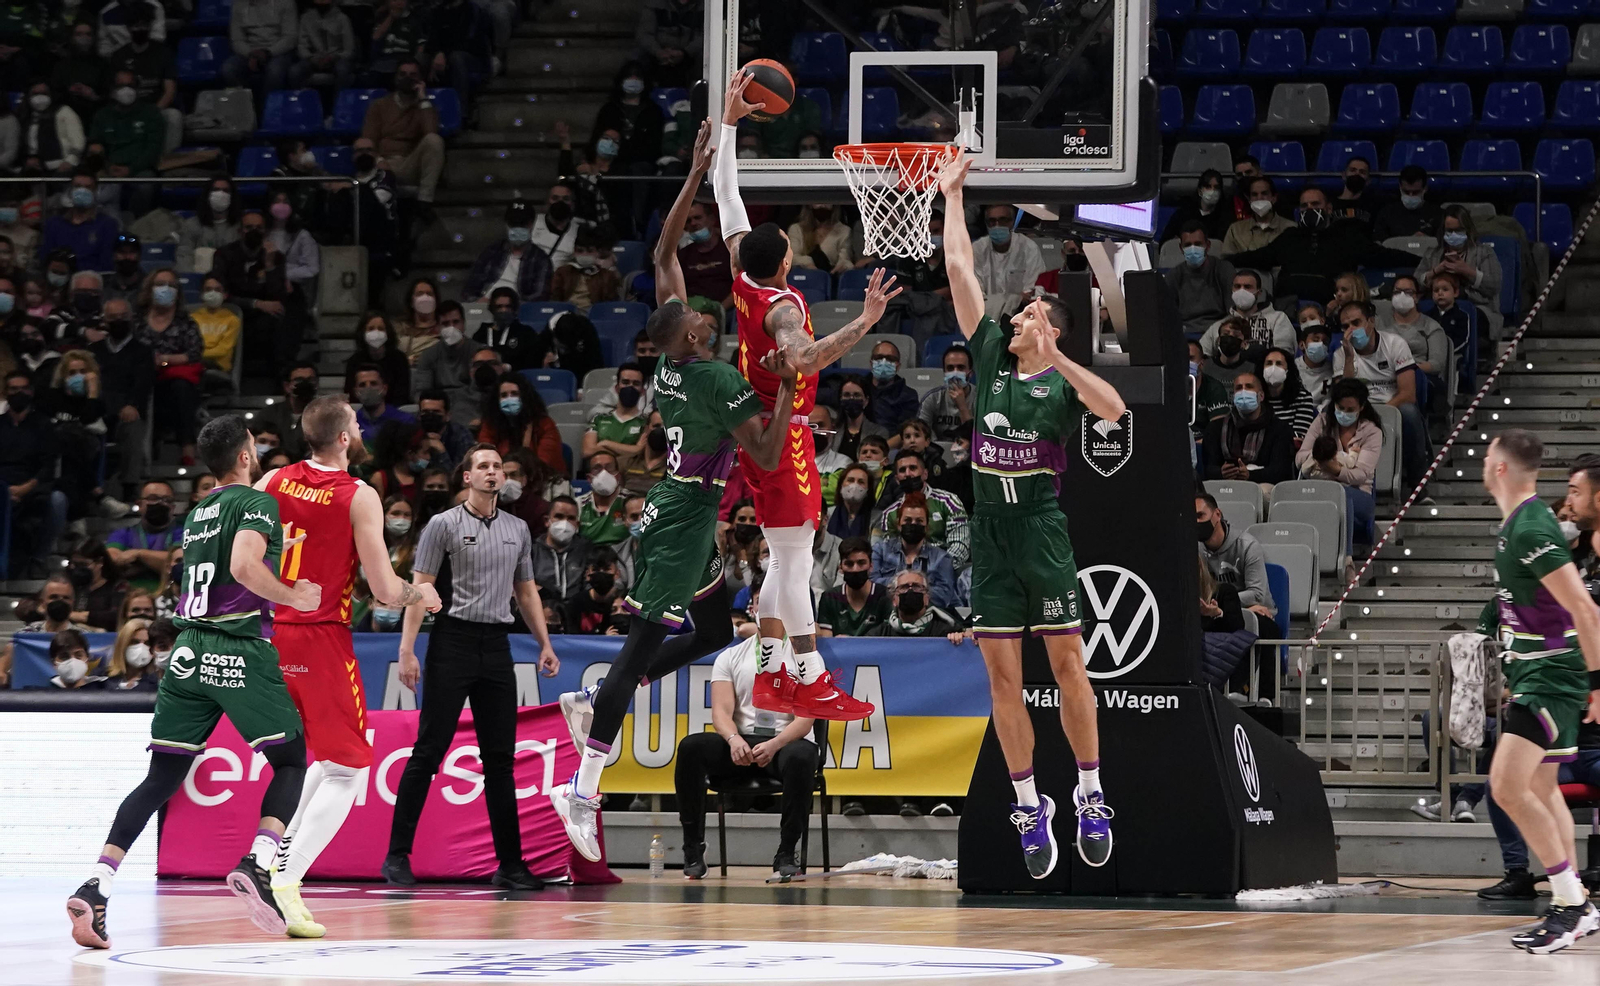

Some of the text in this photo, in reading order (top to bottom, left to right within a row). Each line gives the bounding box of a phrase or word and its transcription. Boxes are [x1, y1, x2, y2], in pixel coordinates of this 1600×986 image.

[1063, 134, 1085, 146] liga
[1063, 144, 1108, 155] endesa
[1007, 428, 1039, 441] Unicaj
[1092, 441, 1122, 451] Unicaja
[278, 478, 335, 505] RADOVIĆ
[1000, 477, 1018, 504] 11
[184, 562, 215, 619] 13
[201, 653, 246, 668] COSTA
[200, 665, 246, 678] DEL SOL
[200, 675, 246, 688] MÁLAGA
[1104, 690, 1179, 714] Wagen
